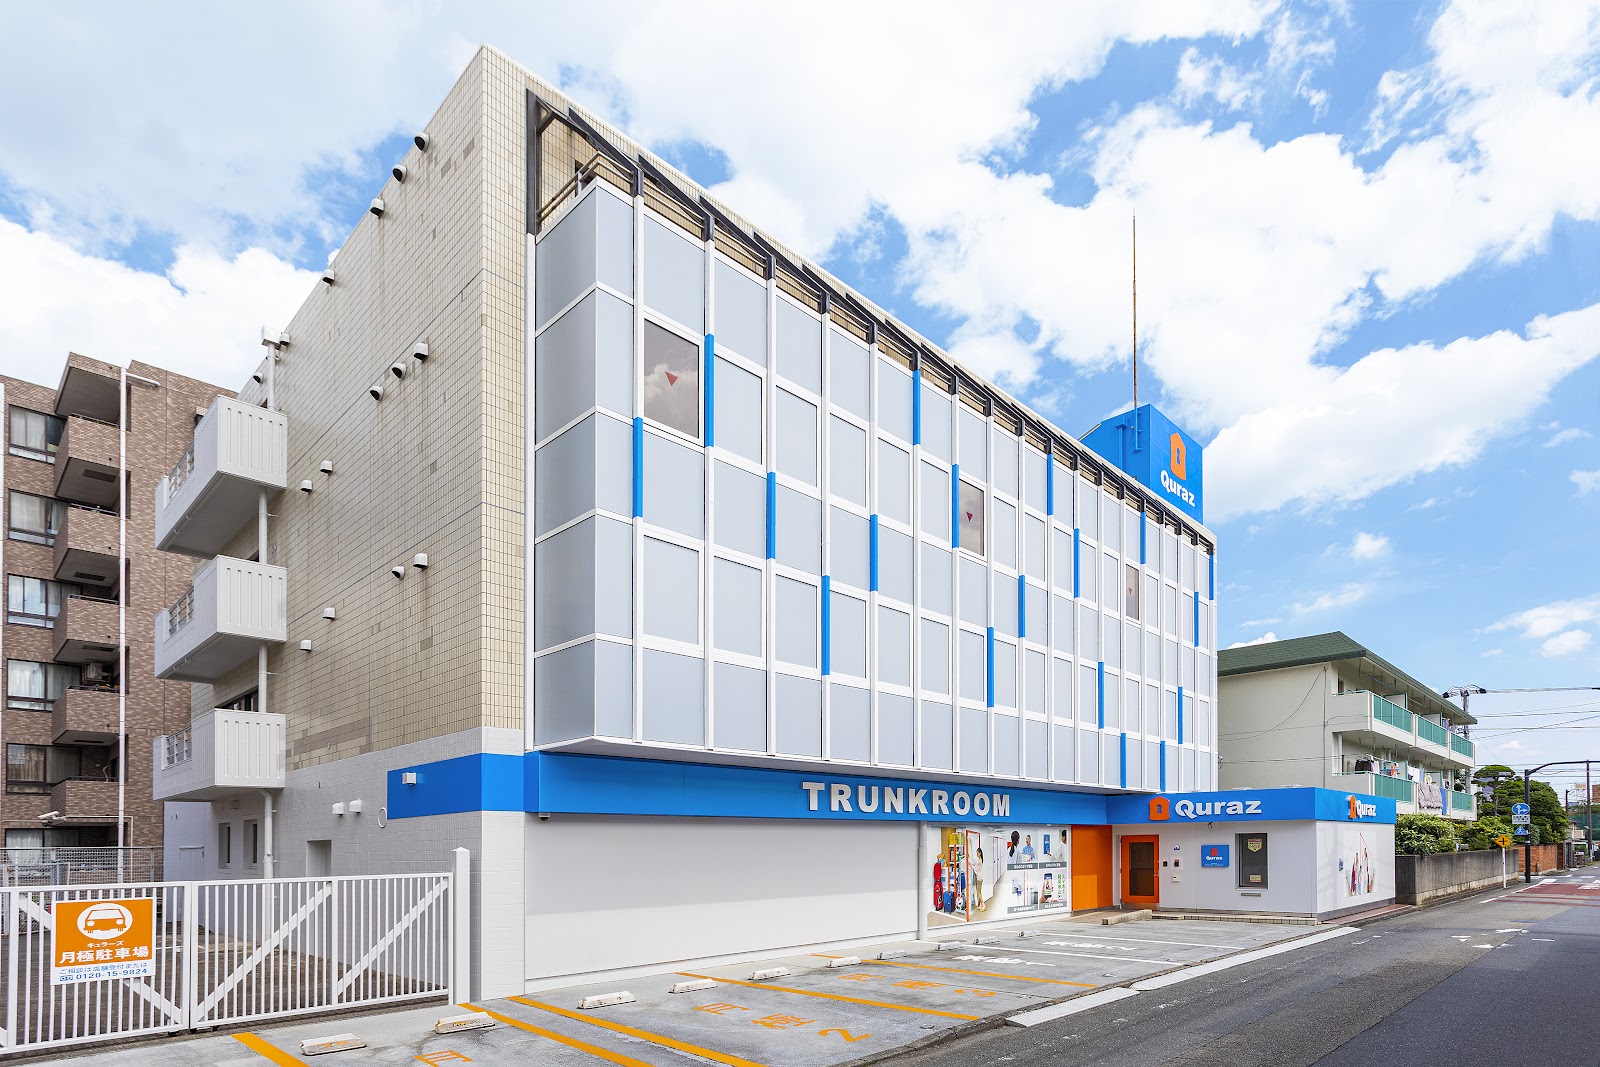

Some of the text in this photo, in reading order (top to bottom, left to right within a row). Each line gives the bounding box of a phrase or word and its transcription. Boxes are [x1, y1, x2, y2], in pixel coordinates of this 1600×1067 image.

[1160, 469, 1196, 507] Quraz
[802, 781, 1010, 817] TRUNKROOM
[1356, 799, 1377, 818] Quraz
[1174, 799, 1262, 819] Quraz
[87, 940, 124, 948] キュラーズ
[59, 945, 149, 964] 月極駐車場
[75, 968, 148, 980] 0120-15-9824
